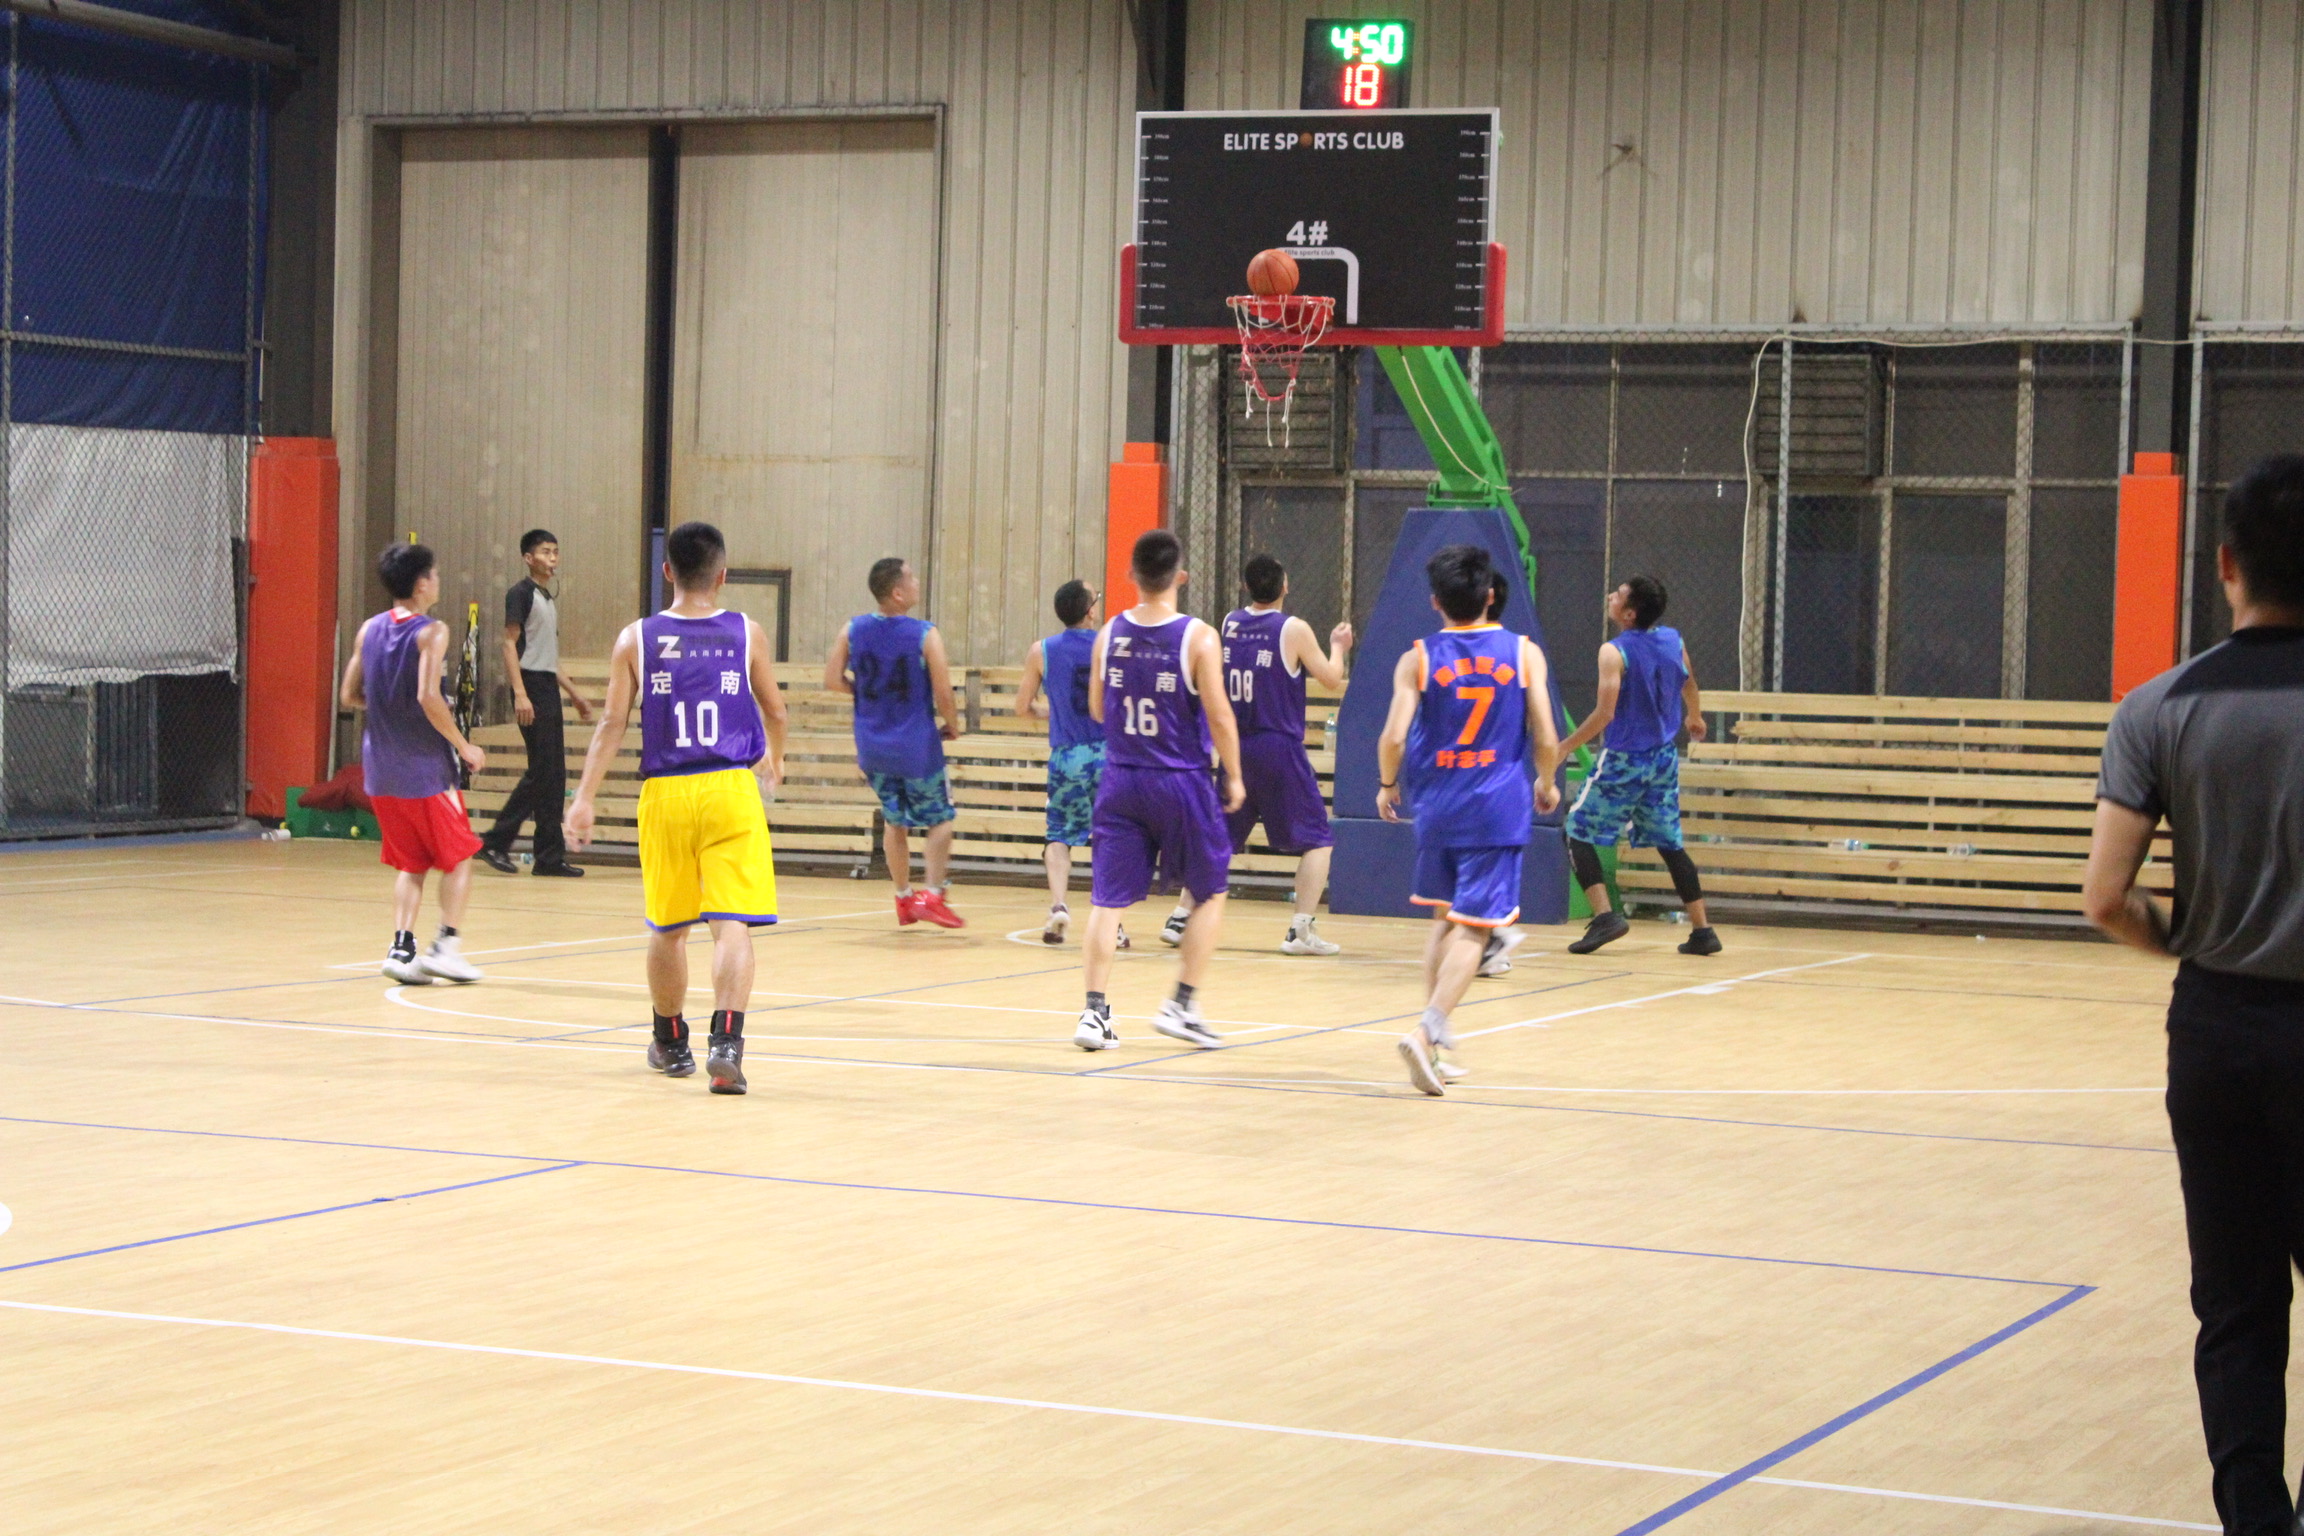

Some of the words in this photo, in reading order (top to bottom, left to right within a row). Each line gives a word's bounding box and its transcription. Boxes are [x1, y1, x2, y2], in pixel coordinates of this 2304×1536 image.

[1331, 24, 1404, 64] 4:50
[1344, 64, 1380, 106] 18
[1223, 133, 1270, 151] ELITE
[1353, 131, 1404, 150] CLUB
[1286, 220, 1328, 246] 4#
[1299, 249, 1320, 257] sports
[1320, 248, 1335, 256] club
[658, 635, 681, 658] Z
[1113, 636, 1132, 657] Z
[1255, 649, 1273, 668] 南
[651, 670, 672, 695] 定
[720, 669, 741, 696] 南
[859, 651, 910, 701] 24
[1155, 671, 1177, 693] 南
[1229, 668, 1254, 704] 08
[674, 701, 719, 748] 10
[1123, 695, 1159, 737] 16
[1456, 686, 1496, 745] 7
